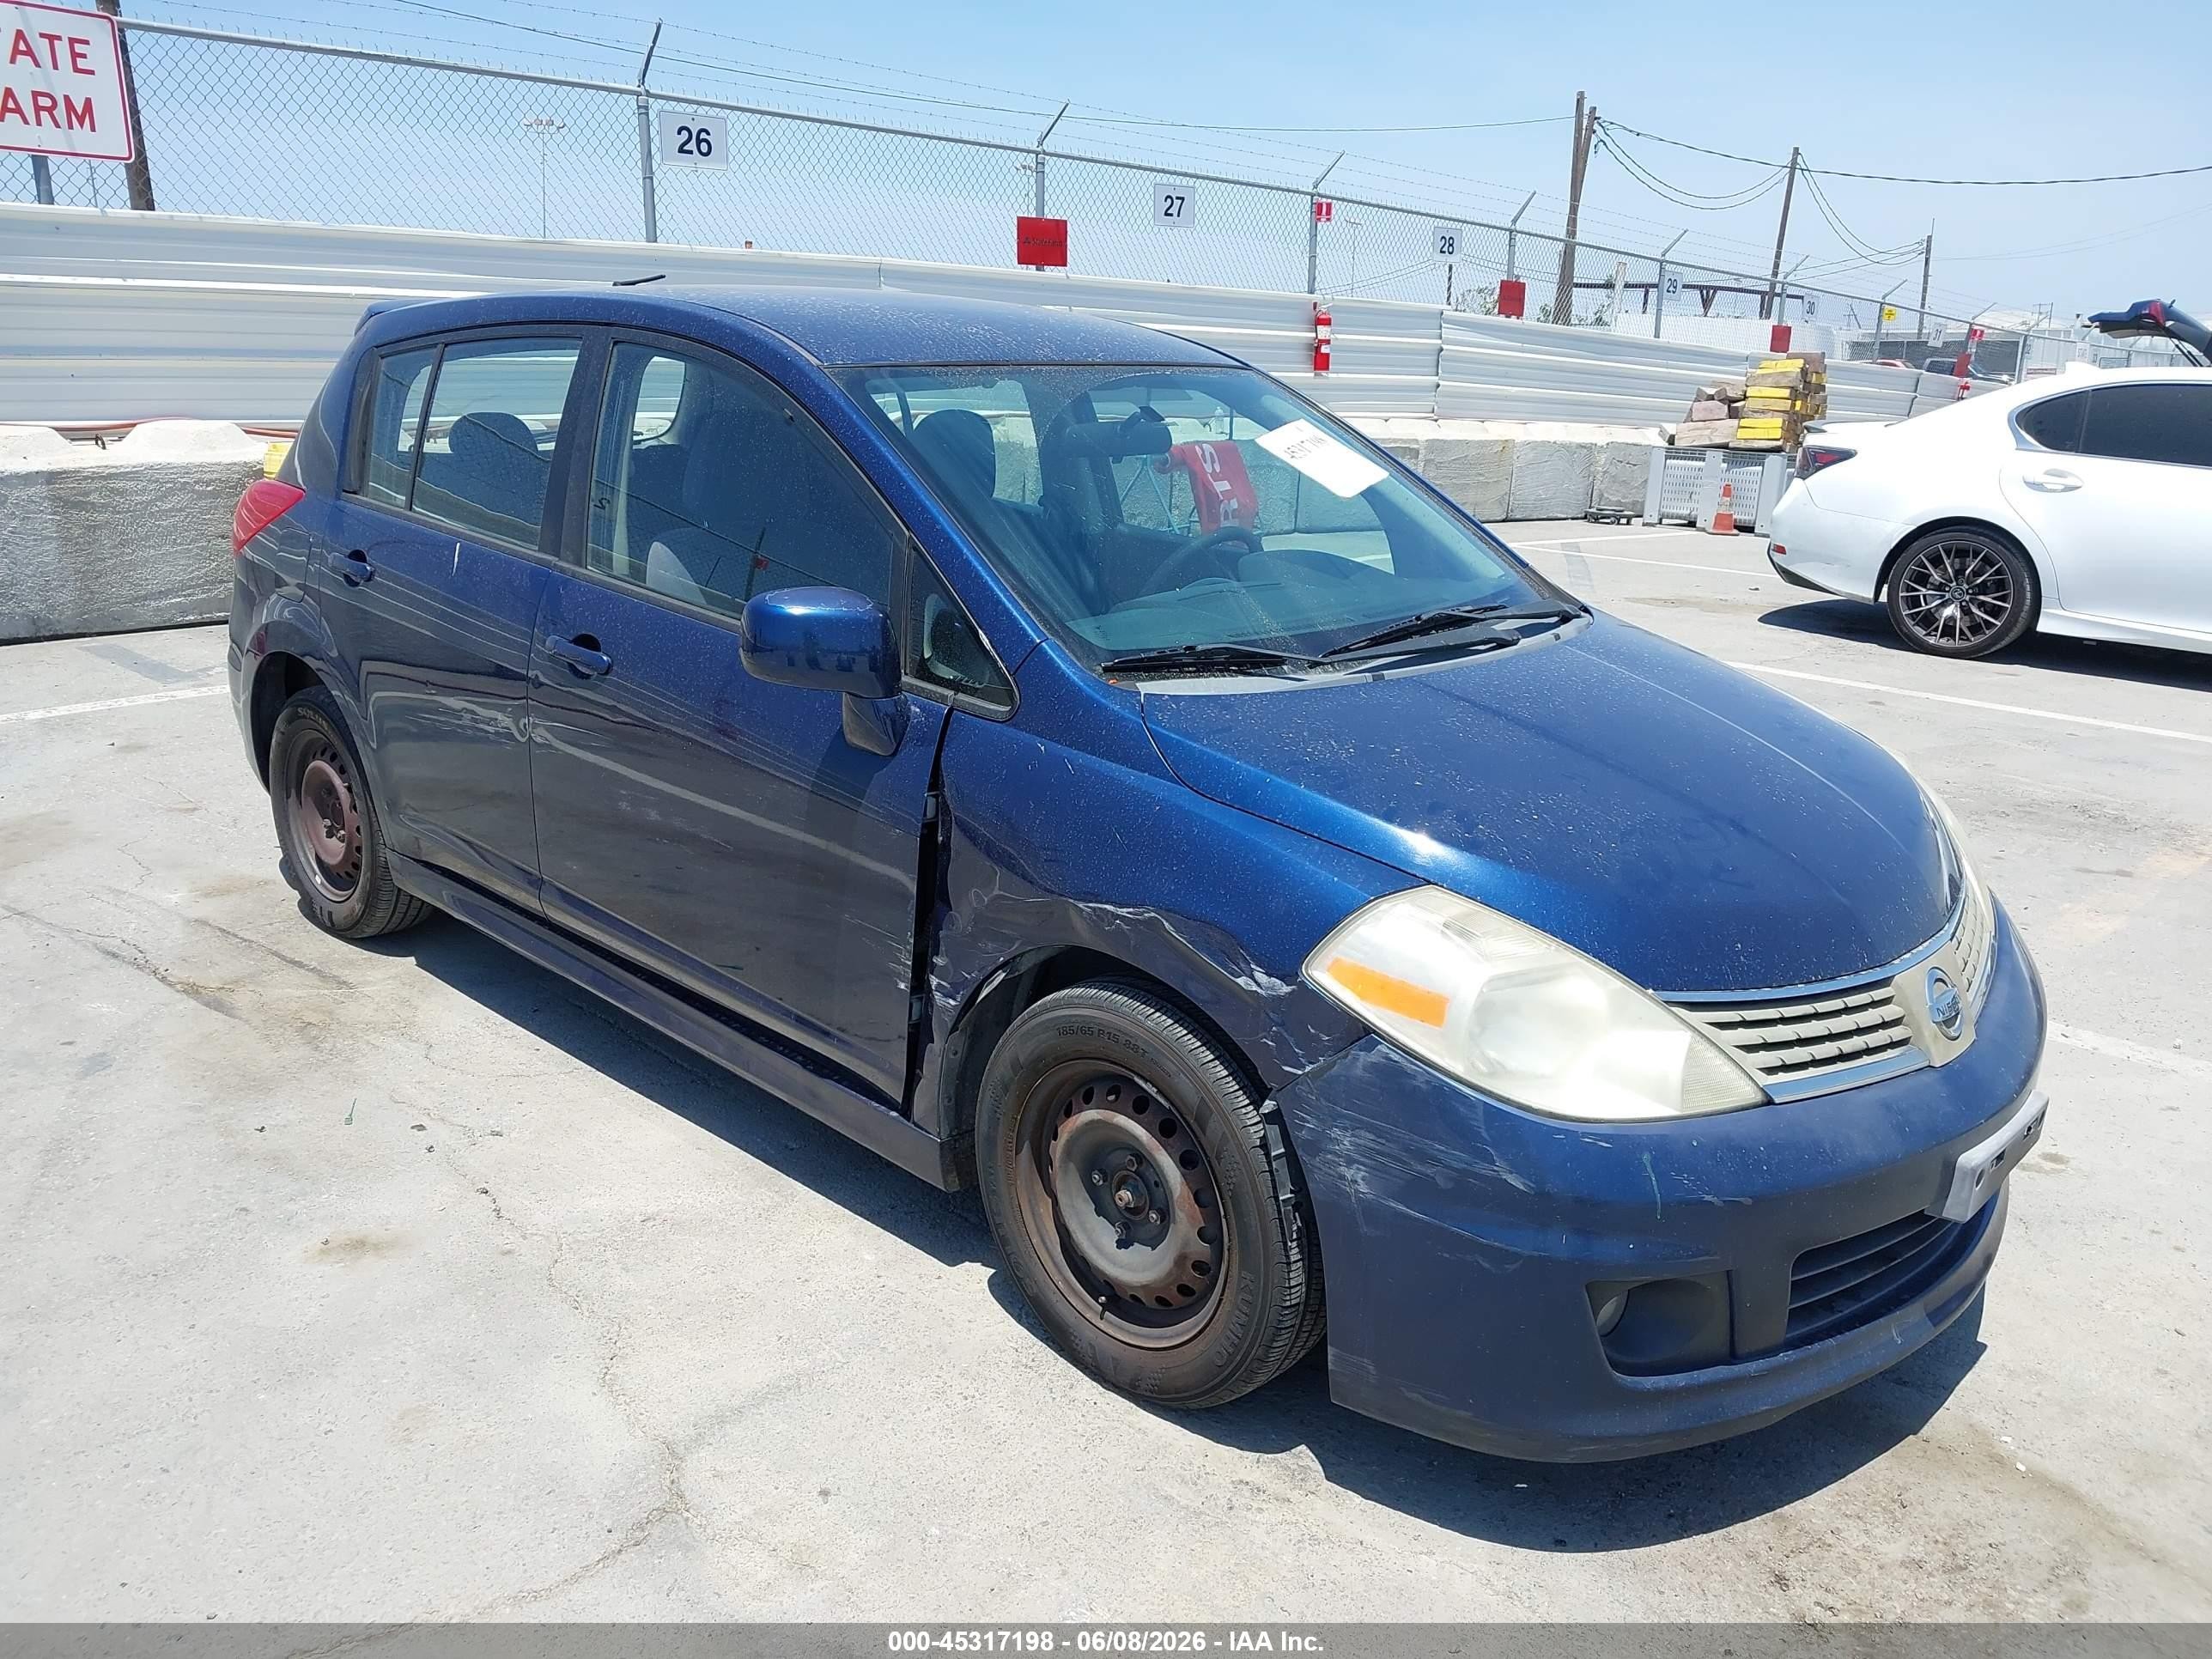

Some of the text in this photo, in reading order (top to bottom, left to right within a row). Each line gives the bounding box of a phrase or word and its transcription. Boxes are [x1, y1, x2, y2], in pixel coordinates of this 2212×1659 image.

[0, 28, 95, 76] ATE
[0, 87, 96, 132] ARM
[677, 125, 713, 157] 26
[1164, 194, 1185, 217] 27
[1439, 235, 1455, 255] 28
[1666, 277, 1678, 294] 29
[1806, 301, 1815, 315] 30
[1932, 328, 1942, 342] 31
[1056, 1024, 1095, 1037] 185/65
[1097, 1029, 1121, 1045] R15
[1213, 1270, 1256, 1367] KUMHO
